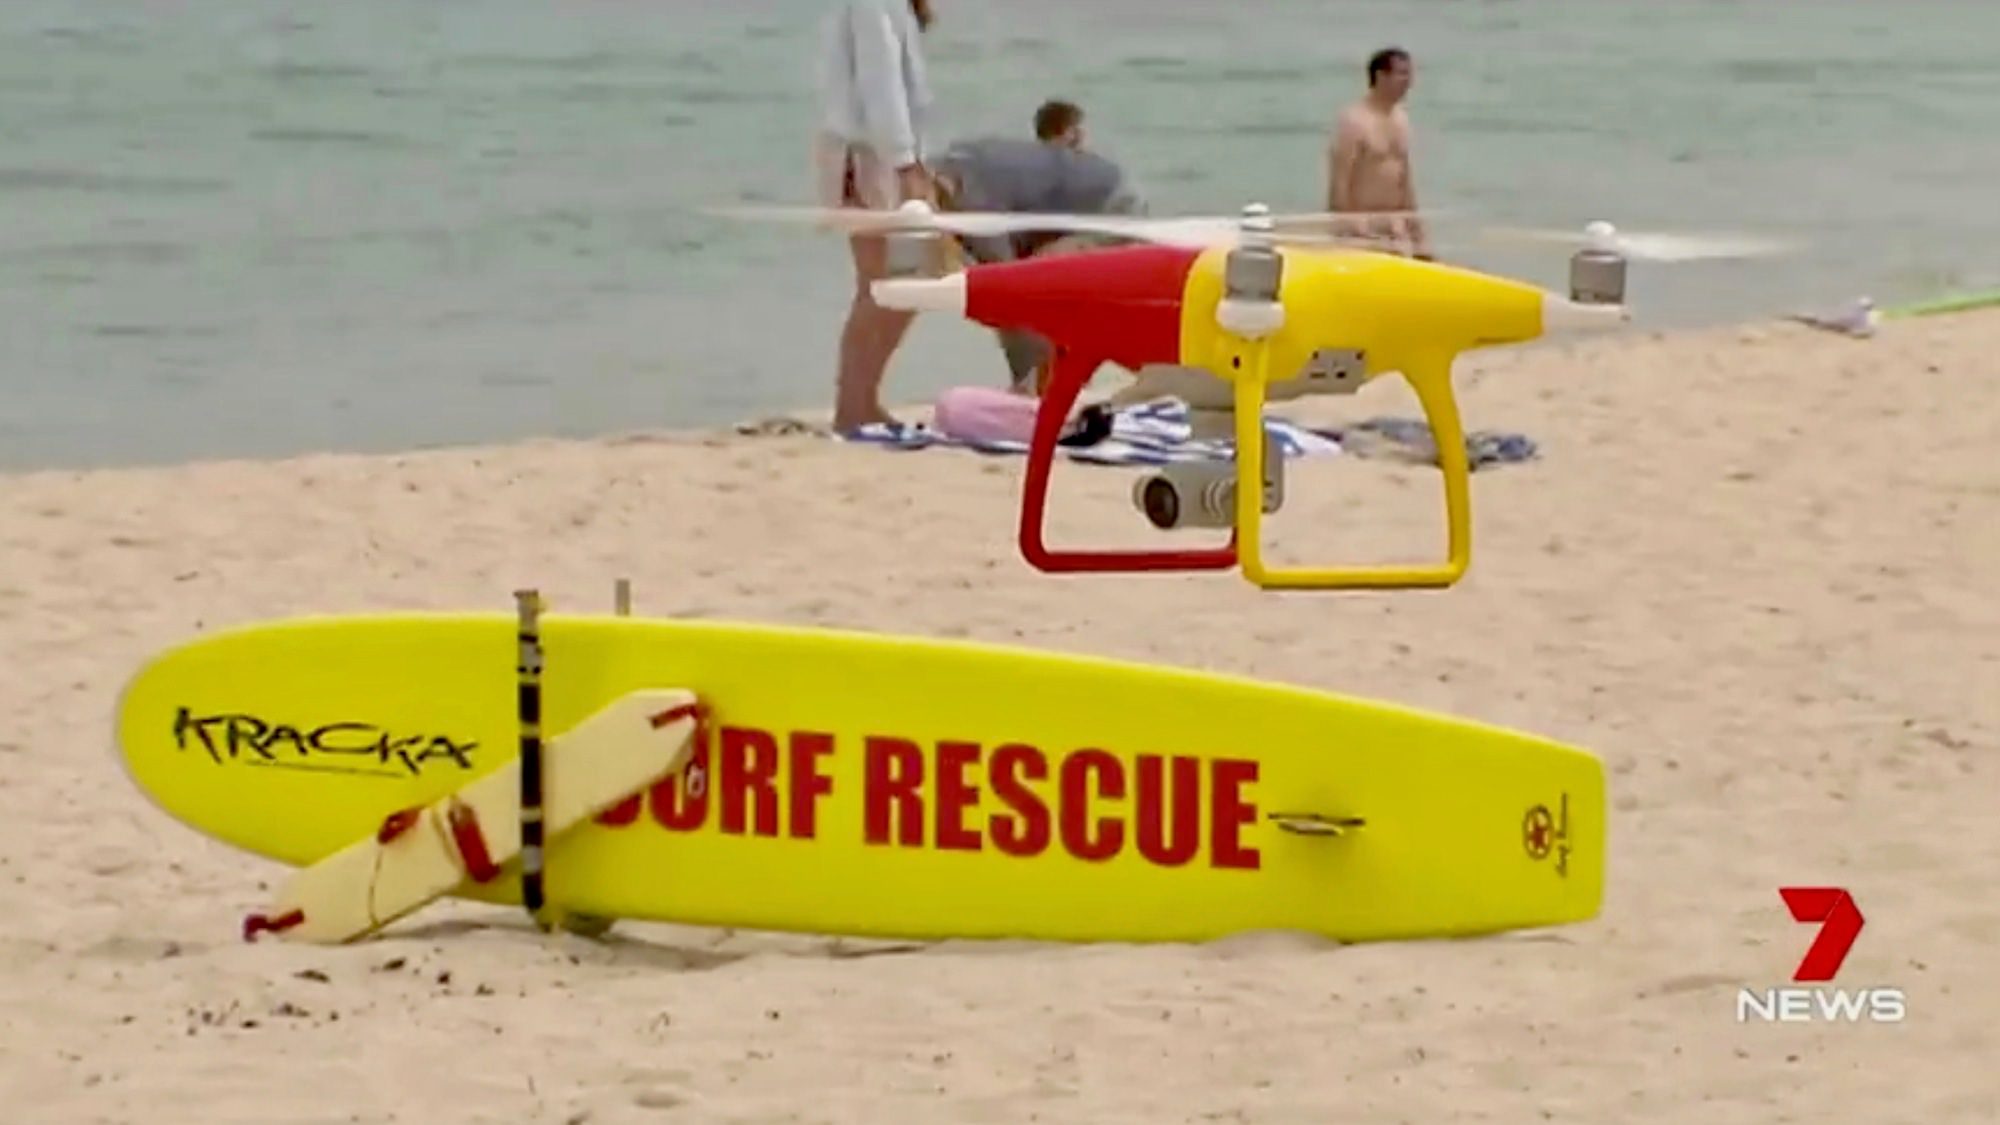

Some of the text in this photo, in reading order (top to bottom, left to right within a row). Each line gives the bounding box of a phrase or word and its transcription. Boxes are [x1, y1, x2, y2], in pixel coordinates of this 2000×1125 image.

[174, 707, 478, 774] KRACKA
[592, 726, 1261, 869] URF RESCUE
